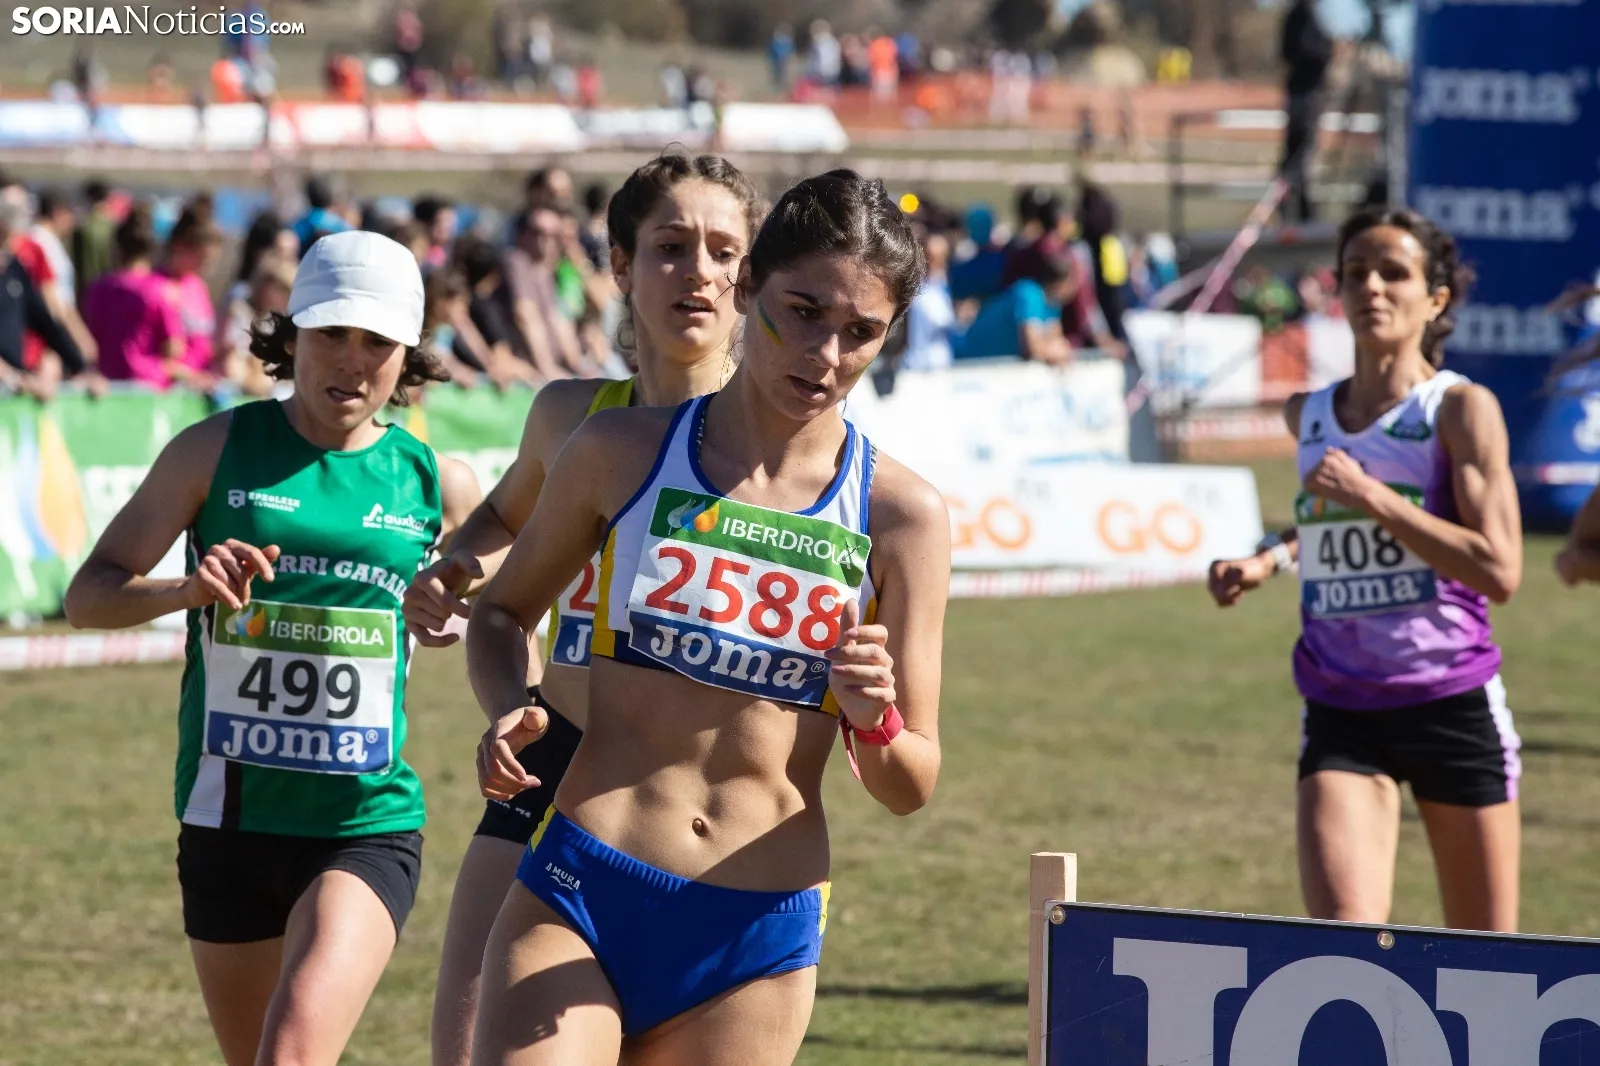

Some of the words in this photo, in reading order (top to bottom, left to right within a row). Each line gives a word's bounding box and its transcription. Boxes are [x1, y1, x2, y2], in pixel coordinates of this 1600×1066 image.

[722, 516, 853, 570] IBERDROLA
[1096, 499, 1204, 554] GO
[1319, 525, 1404, 574] 408
[645, 546, 844, 651] 2588
[269, 619, 385, 647] IBERDROLA
[238, 656, 361, 720] 499
[545, 862, 581, 891] AMURA
